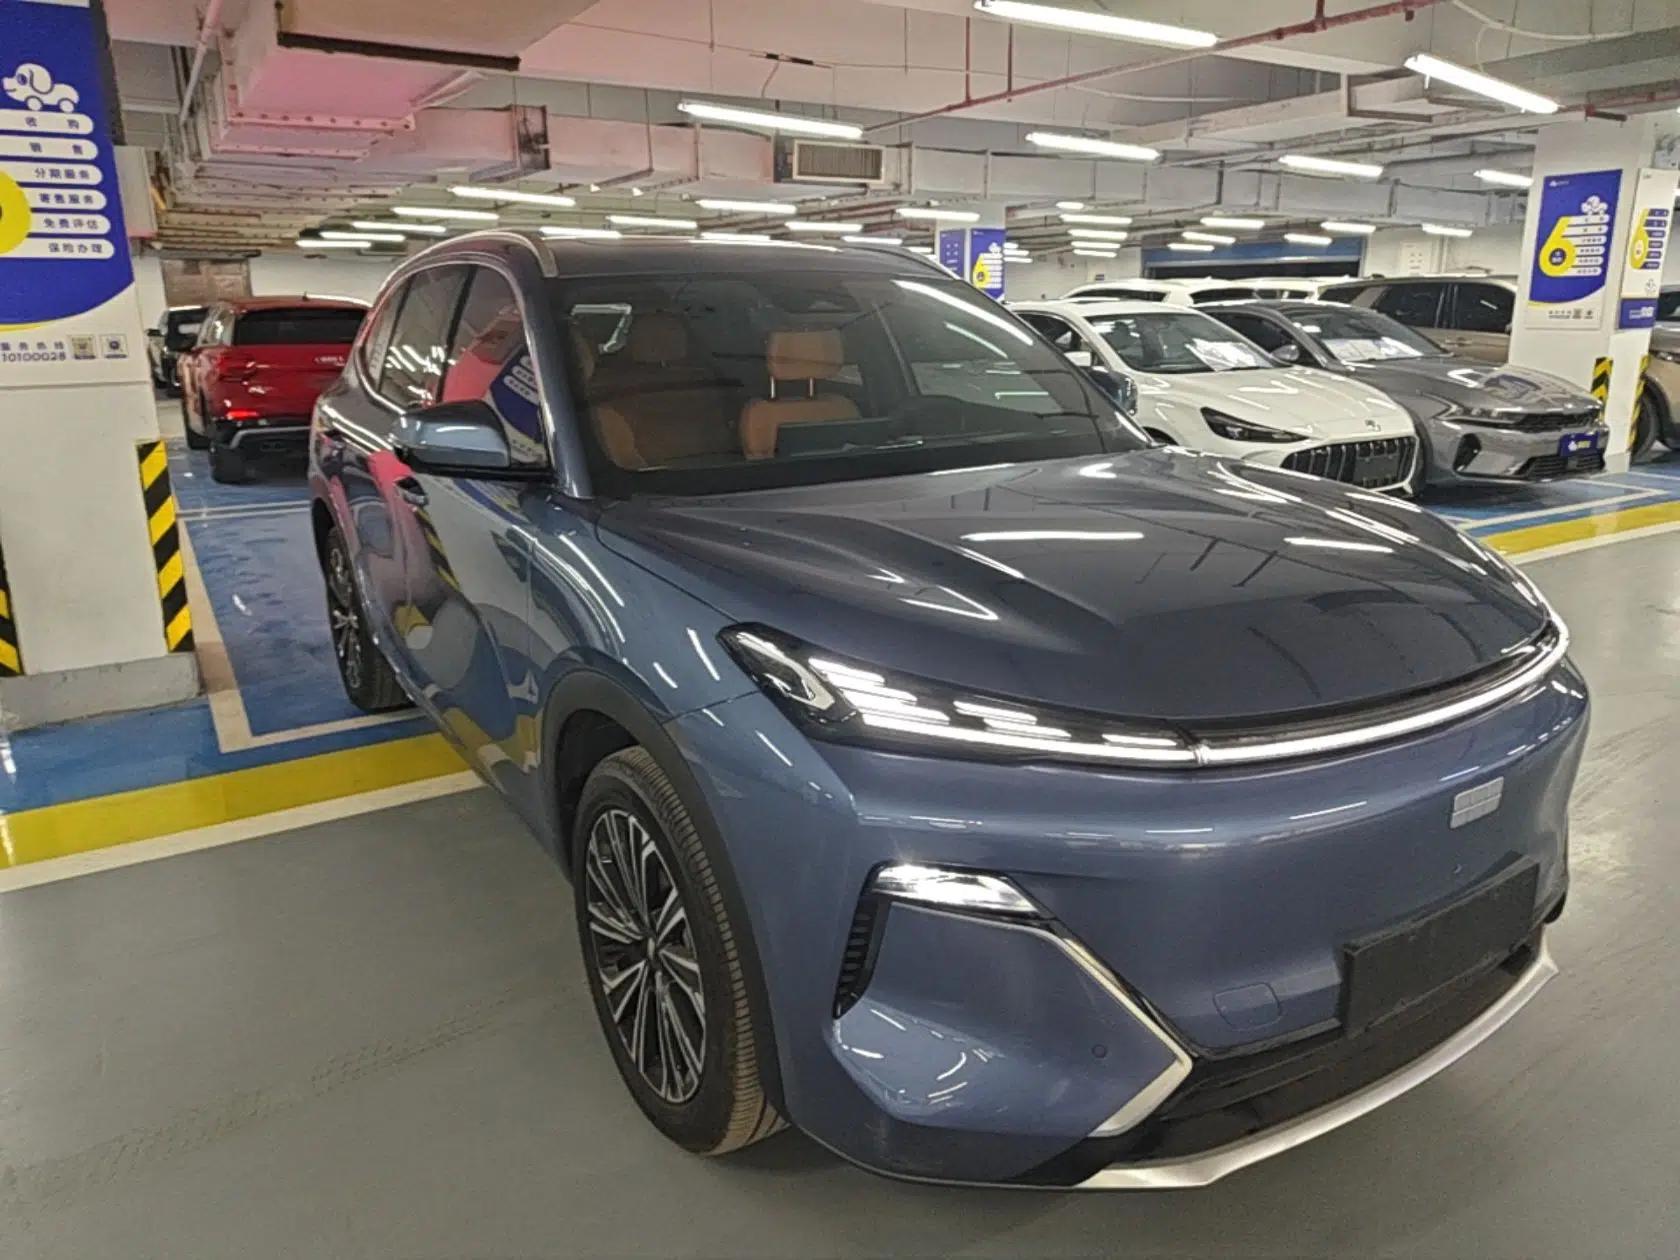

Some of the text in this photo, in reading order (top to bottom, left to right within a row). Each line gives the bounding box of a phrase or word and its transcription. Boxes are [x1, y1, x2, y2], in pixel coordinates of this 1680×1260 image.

[44, 217, 99, 230] 免费评估
[48, 242, 103, 254] 保险办理
